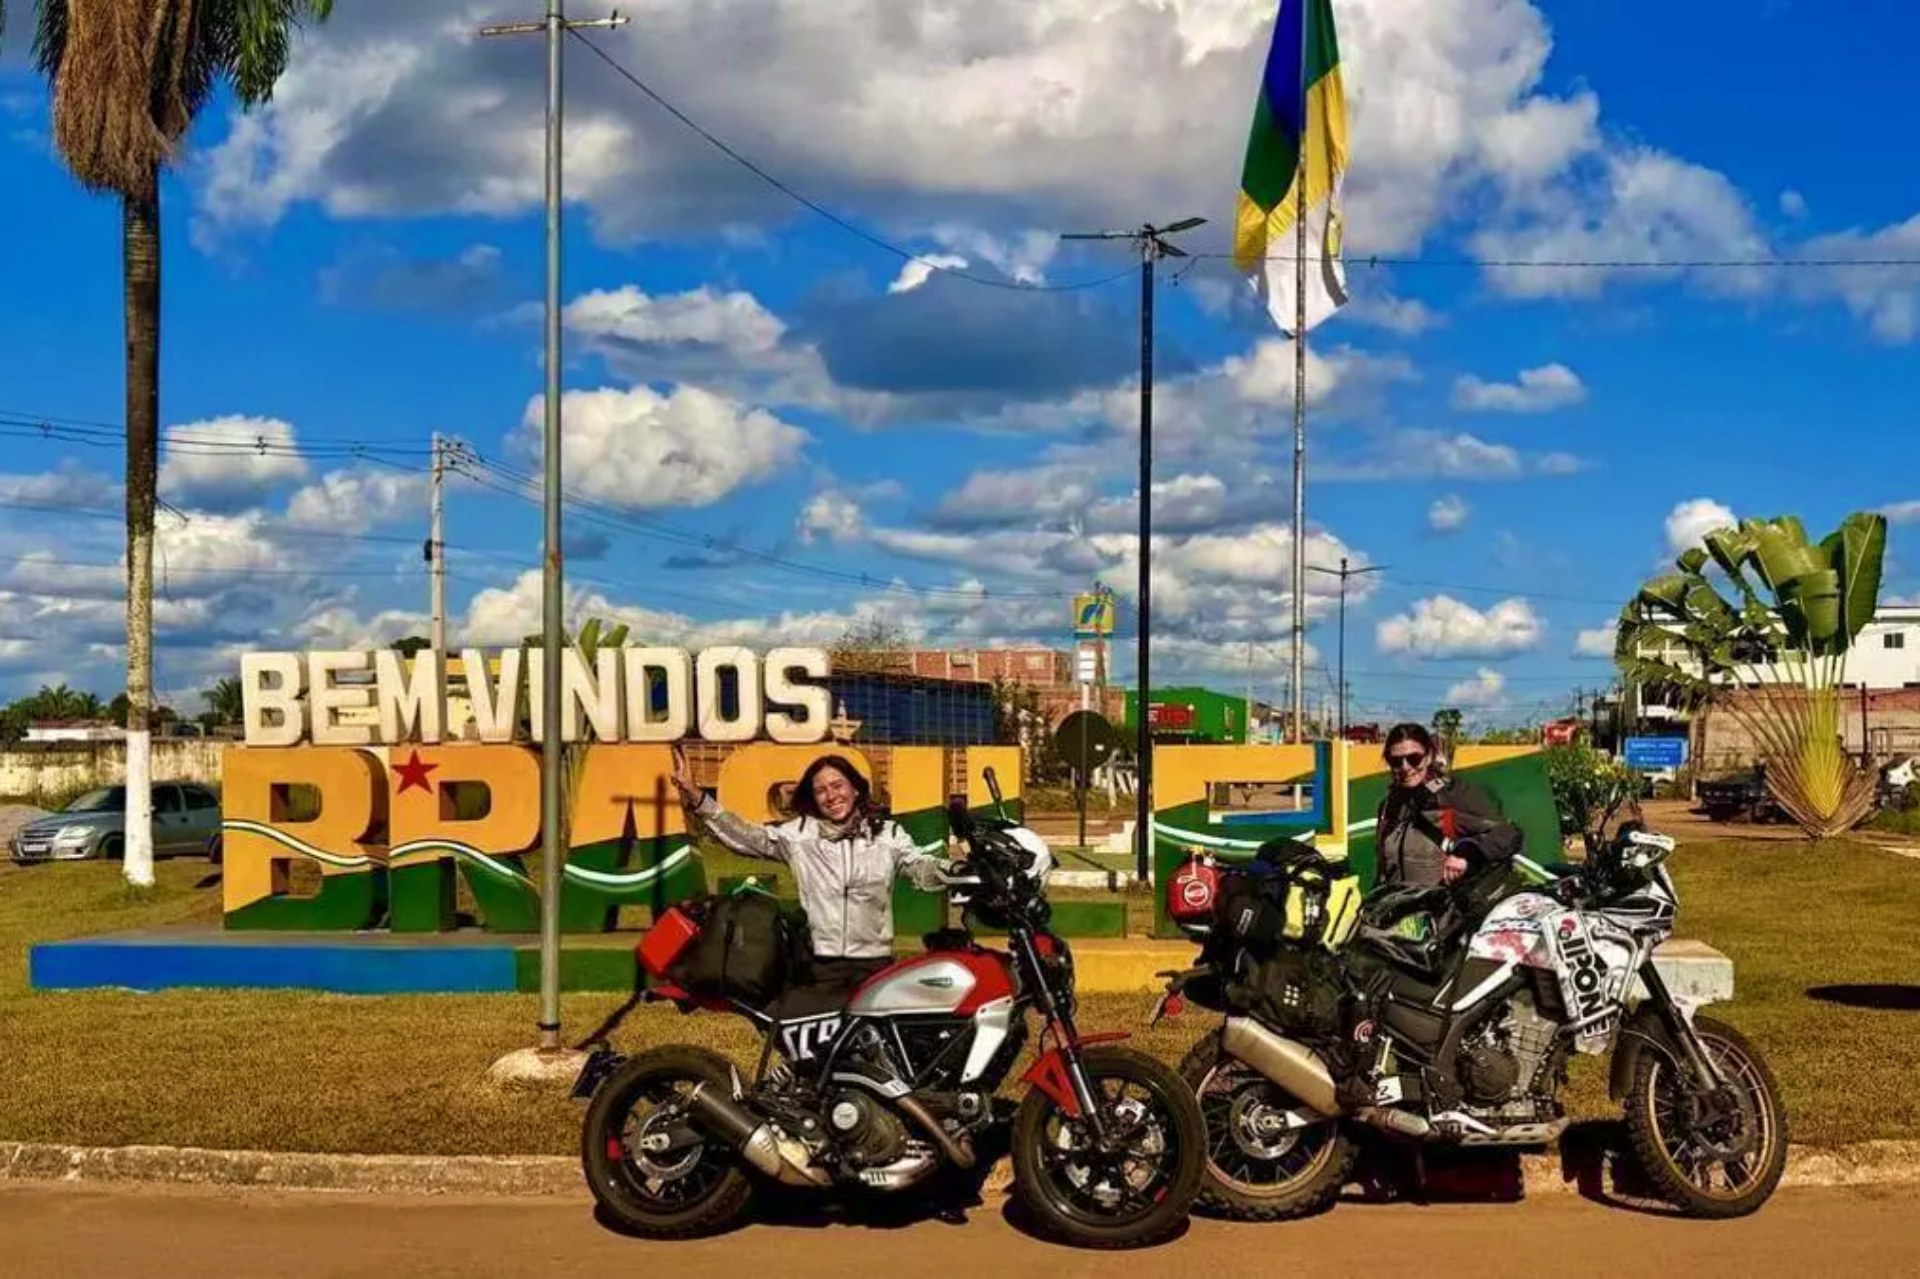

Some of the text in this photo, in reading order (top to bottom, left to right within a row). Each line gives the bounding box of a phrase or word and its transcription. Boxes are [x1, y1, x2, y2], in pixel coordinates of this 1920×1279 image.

[242, 645, 832, 746] BEM VINDOS
[1562, 935, 1610, 1037] IPONE
